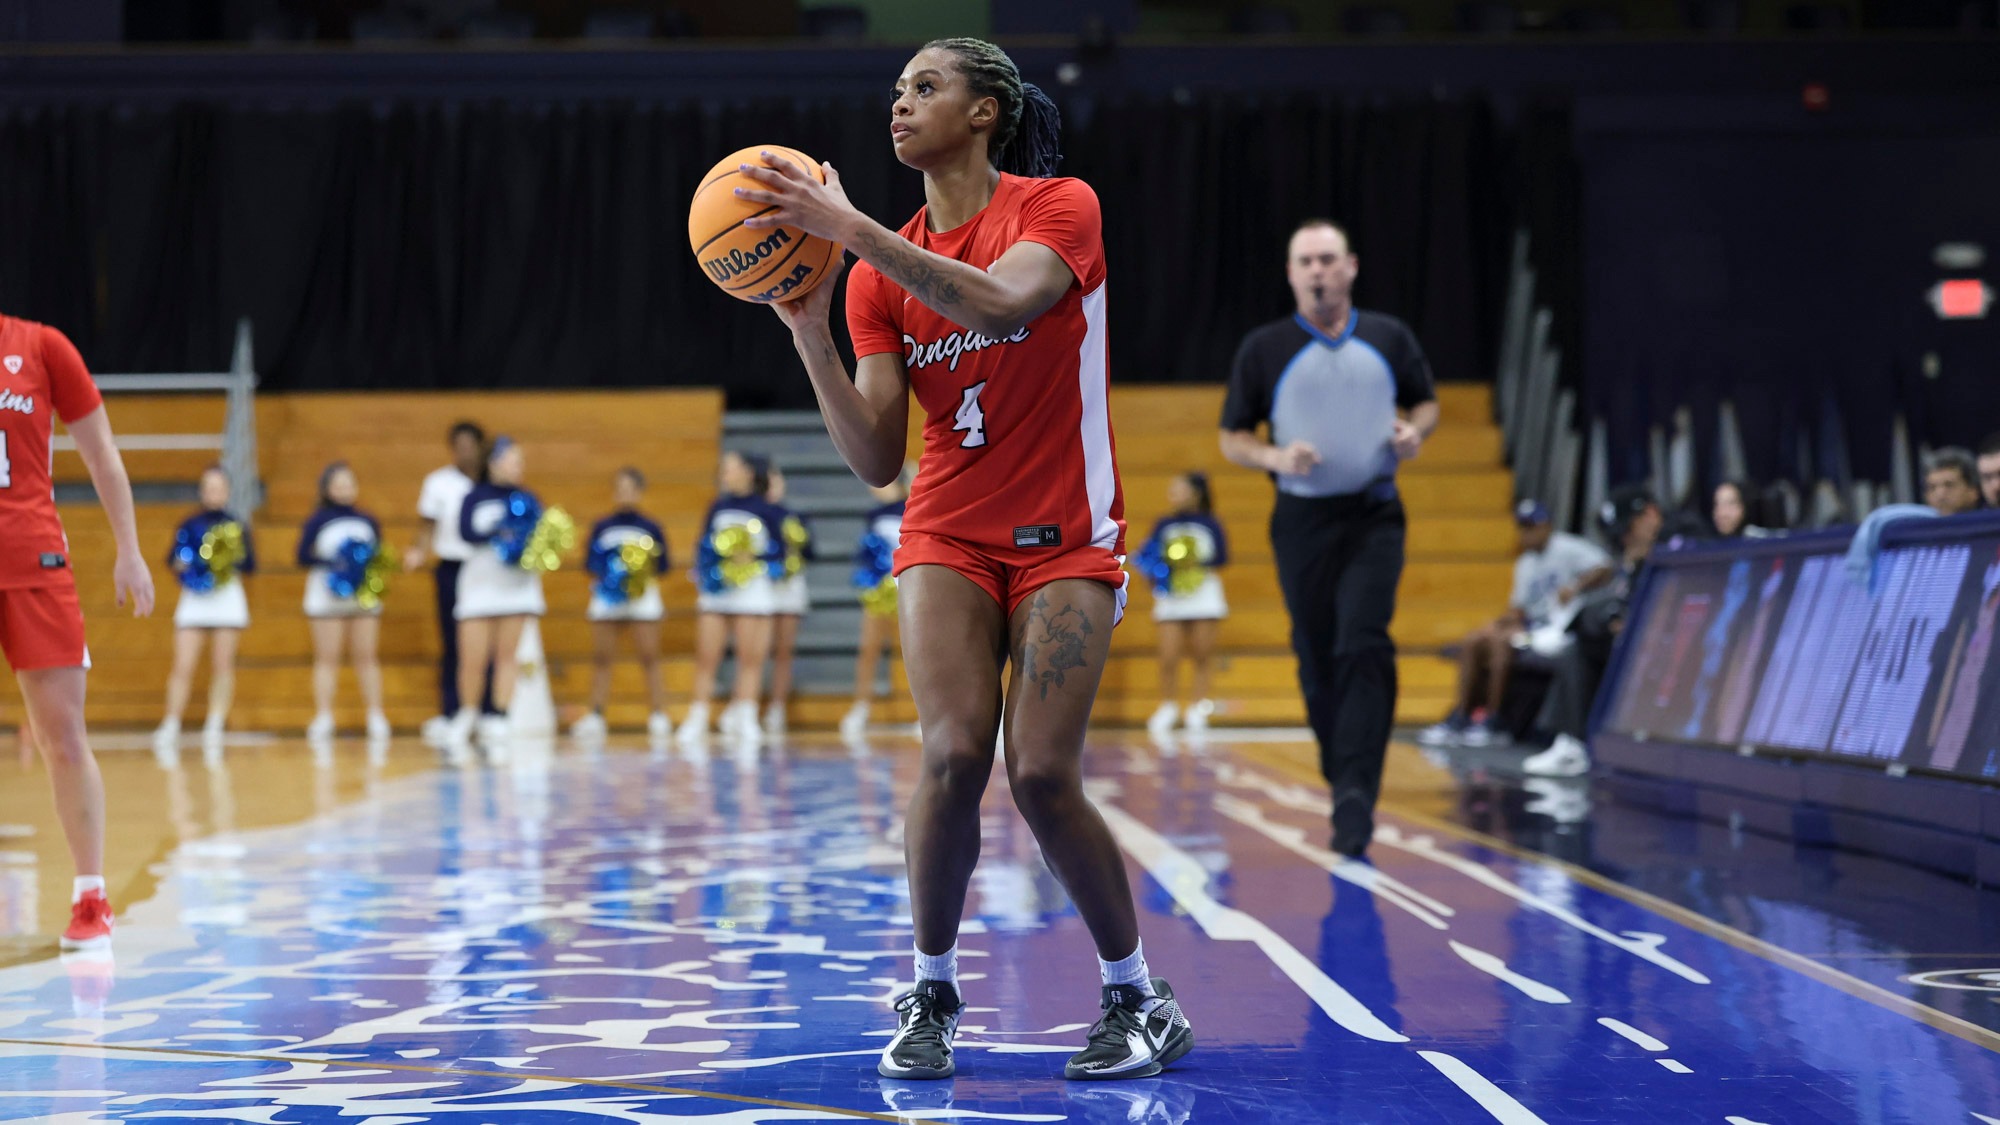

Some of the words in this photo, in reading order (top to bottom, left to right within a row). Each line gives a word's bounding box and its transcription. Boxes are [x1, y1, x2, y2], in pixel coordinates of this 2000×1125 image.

[704, 228, 792, 283] Wilson
[747, 263, 813, 302] NCAA
[952, 380, 987, 448] 4
[1045, 531, 1054, 540] M
